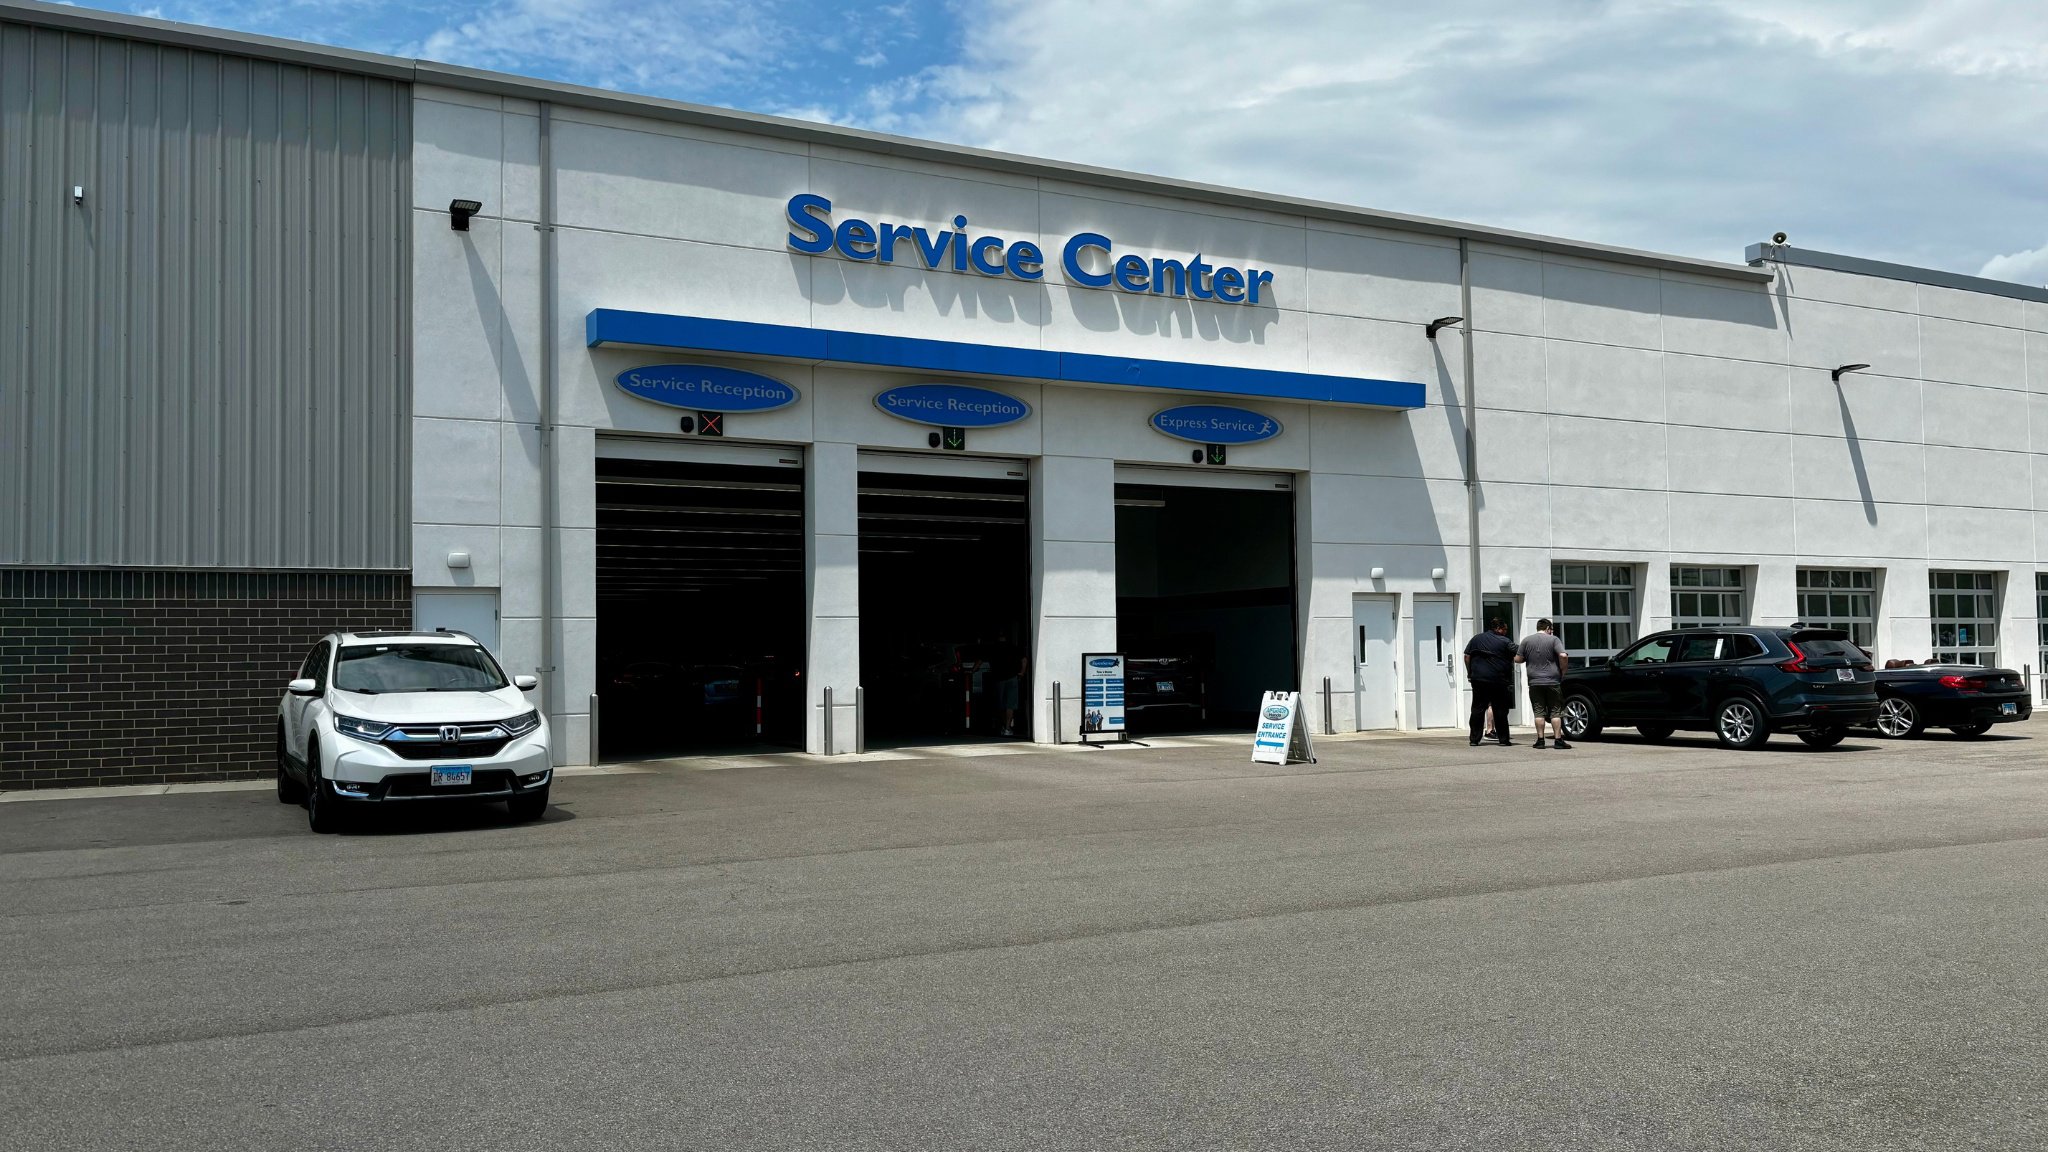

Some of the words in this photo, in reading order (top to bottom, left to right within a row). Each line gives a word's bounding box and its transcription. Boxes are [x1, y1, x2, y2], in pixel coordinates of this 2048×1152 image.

[786, 194, 1043, 280] Service
[1061, 233, 1273, 304] Center
[629, 374, 695, 391] Service
[701, 380, 786, 400] Reception
[887, 394, 943, 409] Service
[947, 398, 1020, 416] Reception
[1160, 415, 1207, 430] Express
[1211, 418, 1255, 432] Service
[1261, 722, 1286, 730] SERVICE
[1257, 731, 1287, 739] ENTRANCE
[446, 771, 469, 781] 84657
